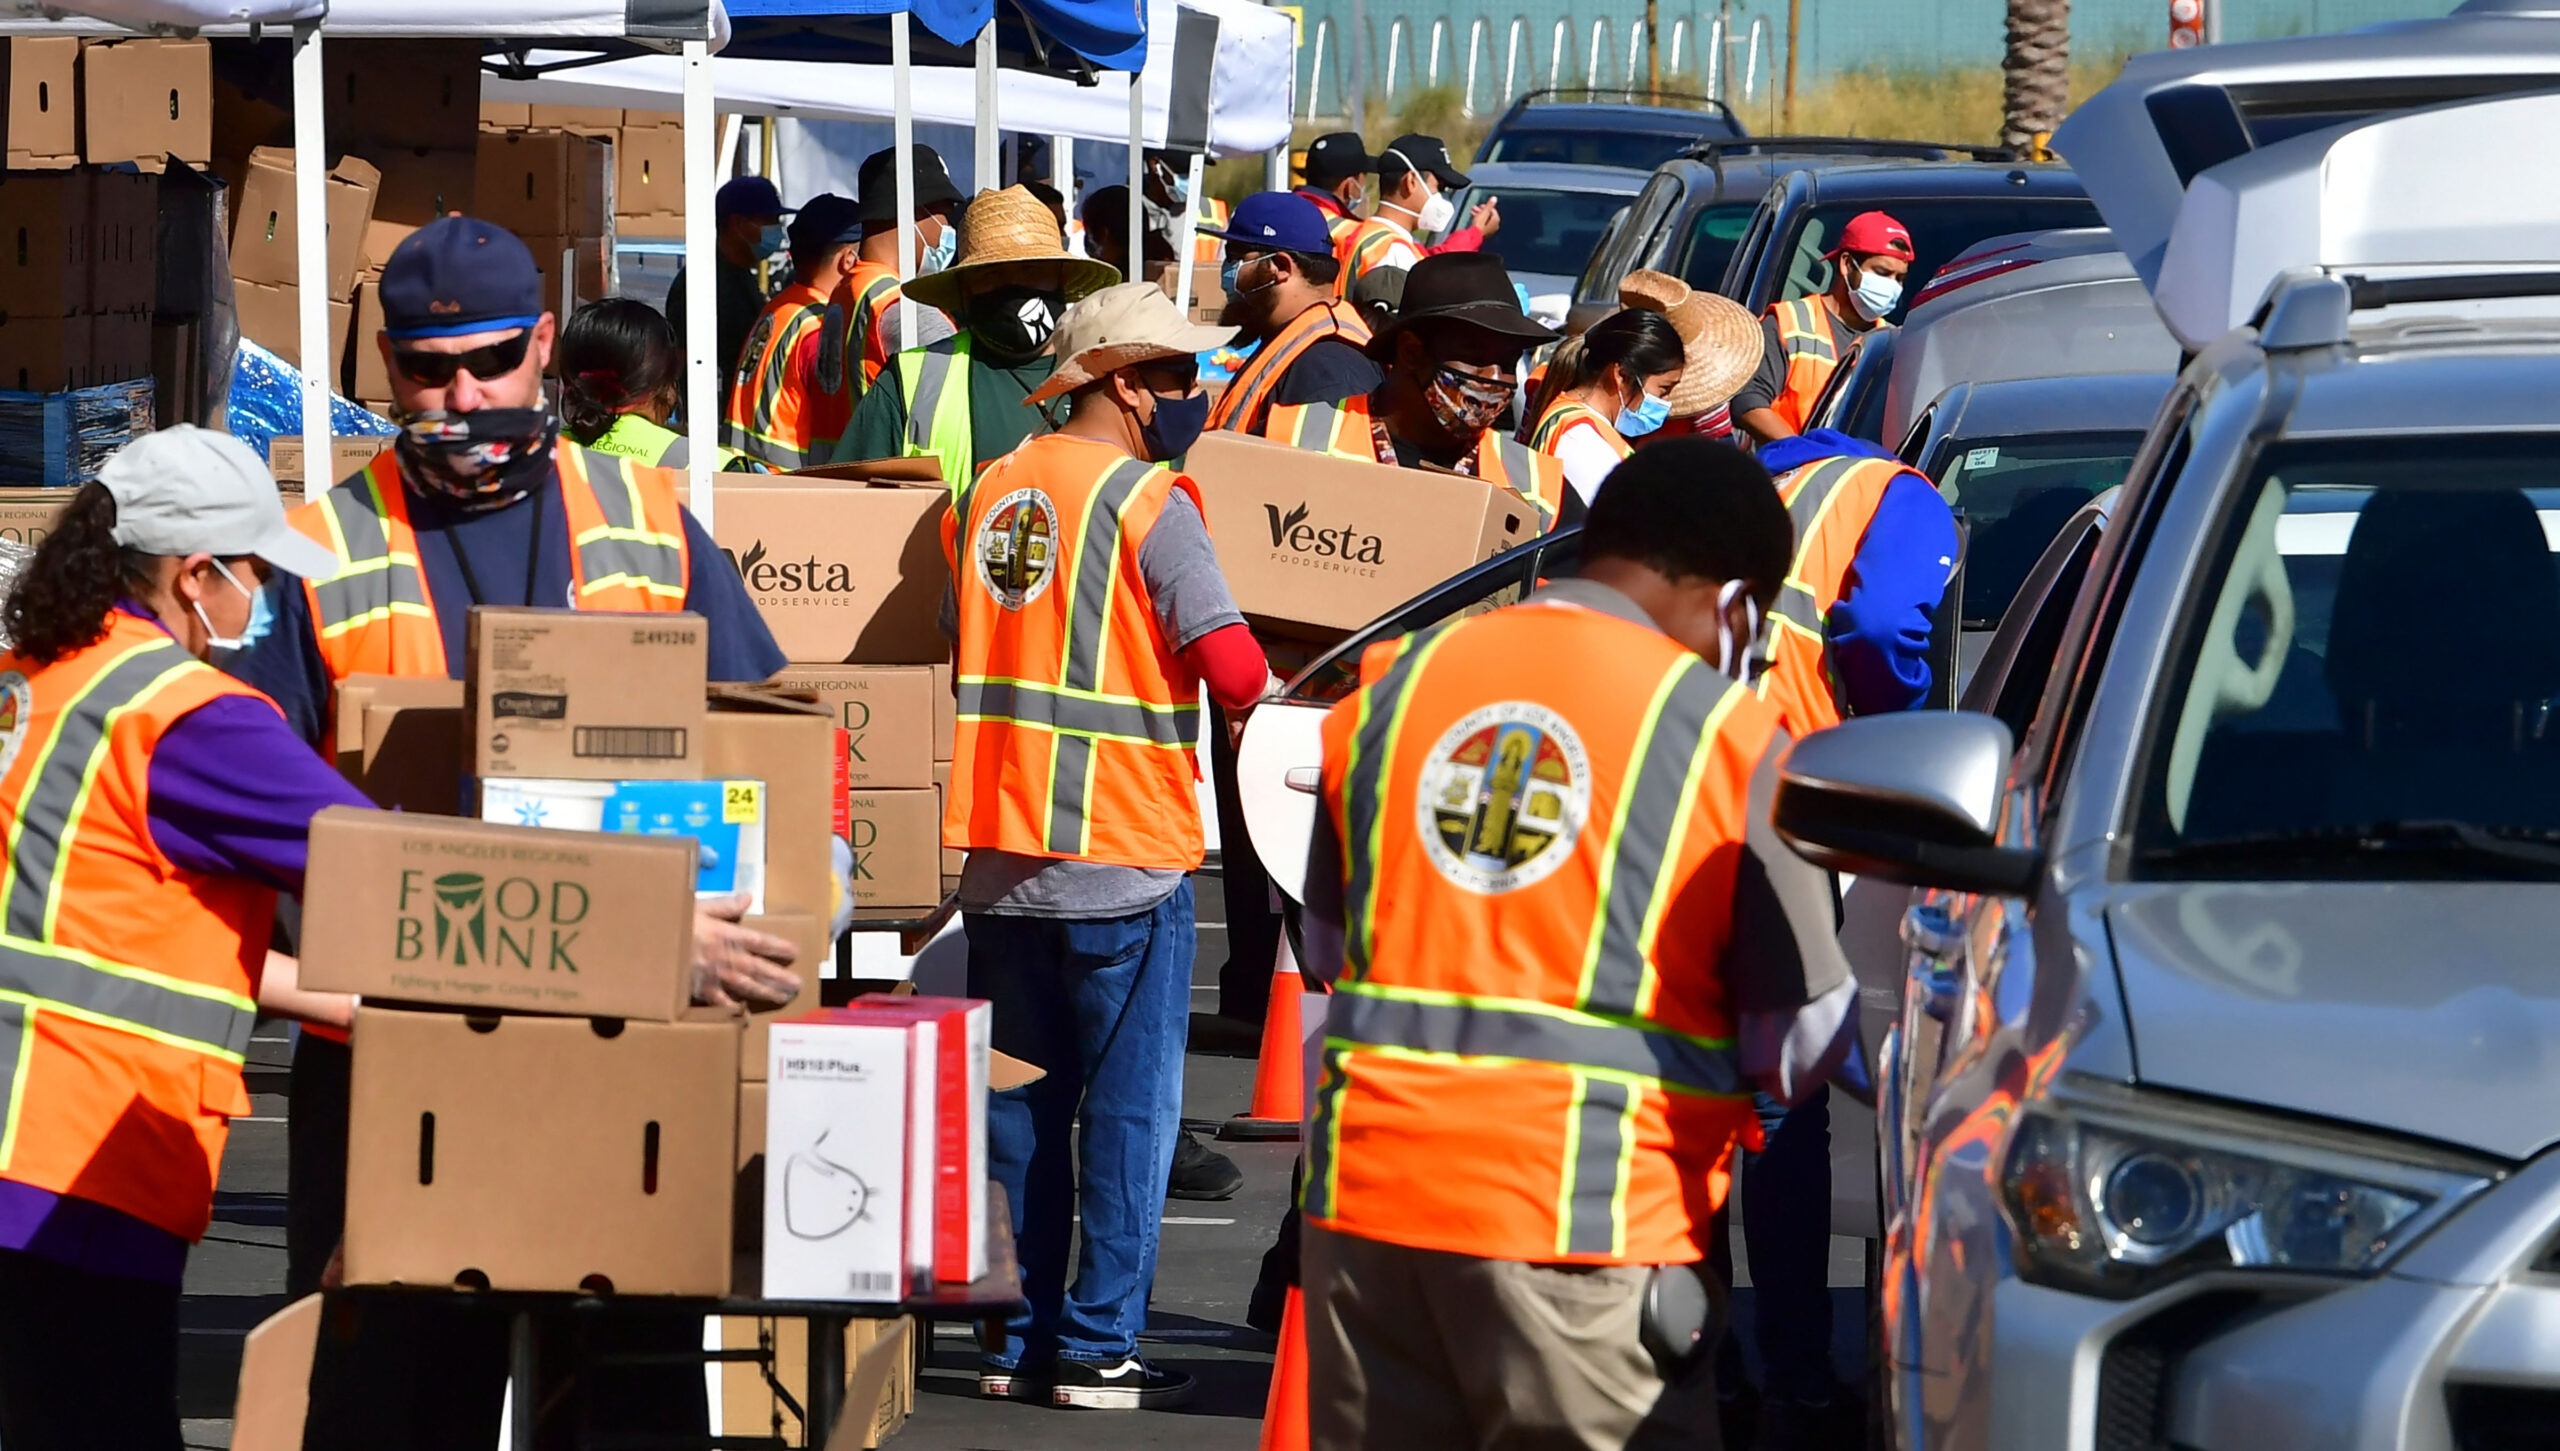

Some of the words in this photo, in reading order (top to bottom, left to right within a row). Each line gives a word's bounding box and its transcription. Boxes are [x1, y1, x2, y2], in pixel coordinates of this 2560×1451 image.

[4, 511, 48, 519] REGIONAL
[985, 495, 1014, 525] COUNTY
[1016, 490, 1028, 499] OF
[1040, 496, 1058, 532] ANGELES
[1263, 500, 1385, 565] Vesta
[1270, 552, 1377, 578] FOODSERVICE
[757, 597, 850, 607] ODSERVICE
[814, 681, 870, 691] REGIONAL
[727, 788, 753, 804] 24
[440, 843, 506, 861] ANGELES
[511, 849, 592, 867] REGIONAL
